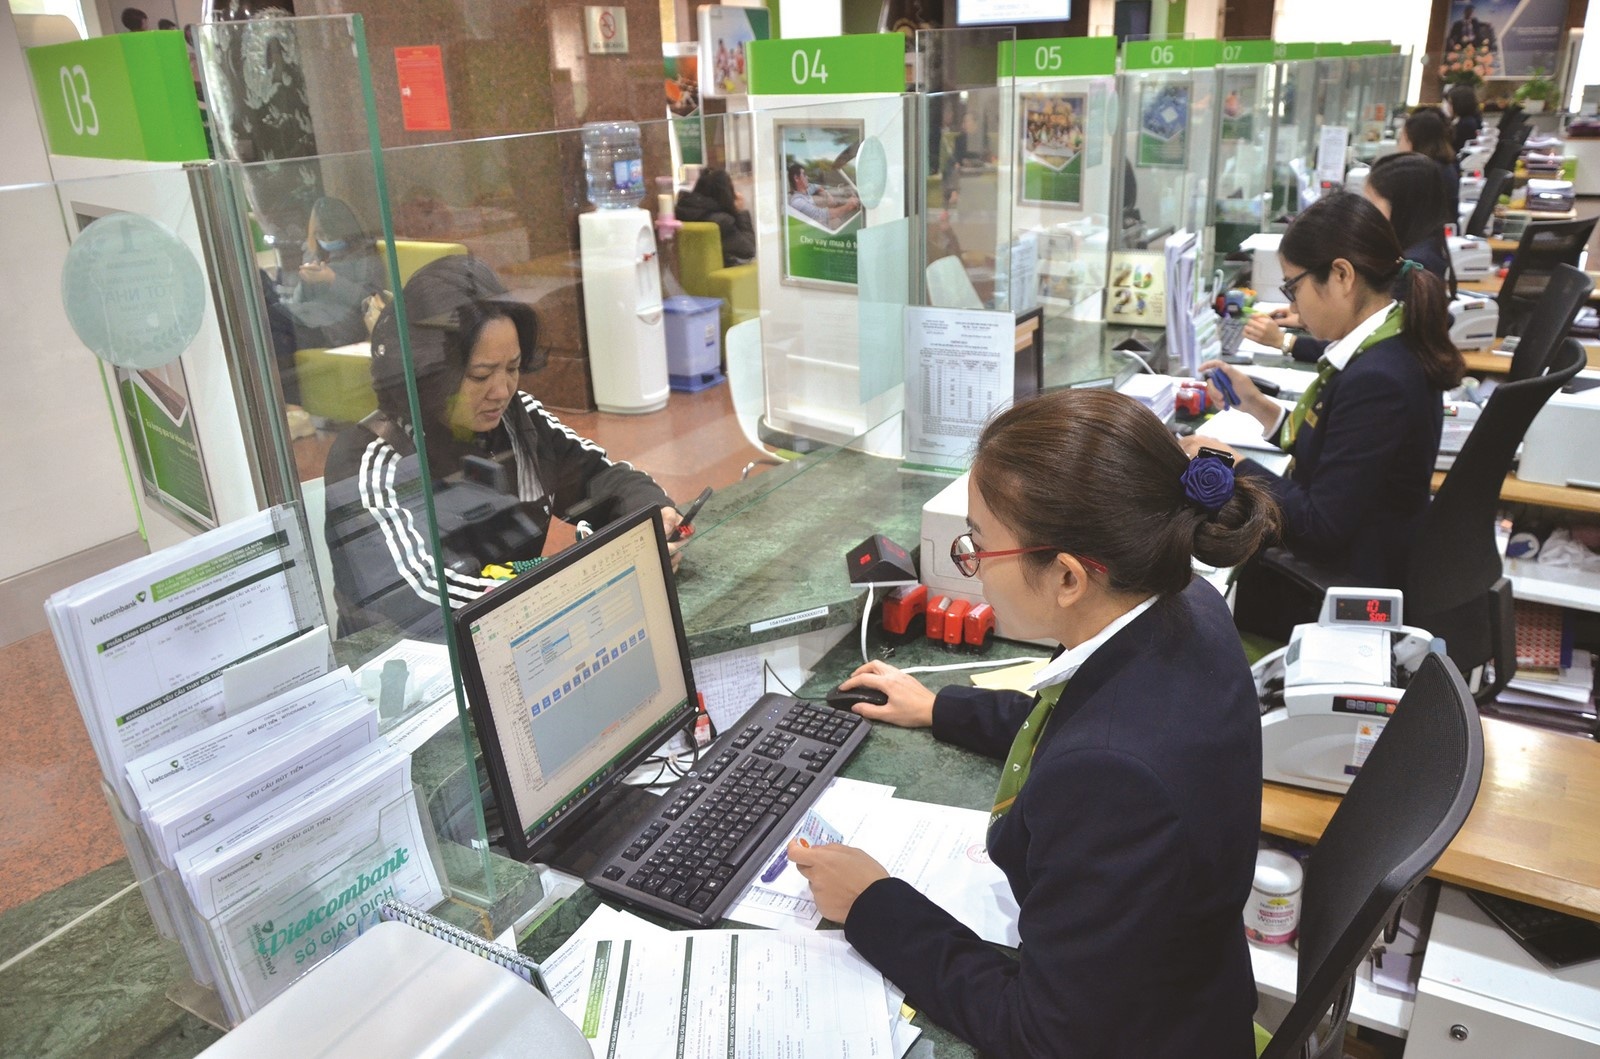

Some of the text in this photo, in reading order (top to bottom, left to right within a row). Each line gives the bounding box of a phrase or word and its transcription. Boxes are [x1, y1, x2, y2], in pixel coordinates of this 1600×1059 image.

[1035, 46, 1062, 70] 05
[1151, 46, 1174, 64] 06
[1223, 46, 1242, 60] 07
[792, 49, 828, 84] 04
[60, 65, 99, 136] 03
[800, 235, 814, 245] Cho
[815, 238, 827, 247] vay
[829, 239, 845, 248] mua
[90, 600, 137, 626] Vietcombank
[138, 623, 152, 633] CHO
[166, 608, 184, 620] HÀNG
[124, 707, 146, 721] KHÁCH
[144, 698, 163, 711] HÀNG
[160, 692, 175, 703] YÊU
[173, 686, 186, 697] CẦU
[184, 679, 201, 691] THAY
[149, 766, 184, 784] Vietcombank
[245, 763, 304, 800] YÊU CẦU RÚT TIỀN
[182, 817, 215, 838] Vietcombank
[269, 839, 286, 852] YÊU
[284, 831, 302, 843] CẦU
[315, 814, 333, 827] TIỀN
[218, 860, 255, 882] Vietcombank
[258, 847, 409, 956] Vietcombank
[295, 936, 317, 964] SỞ
[321, 912, 357, 945] GIAO
